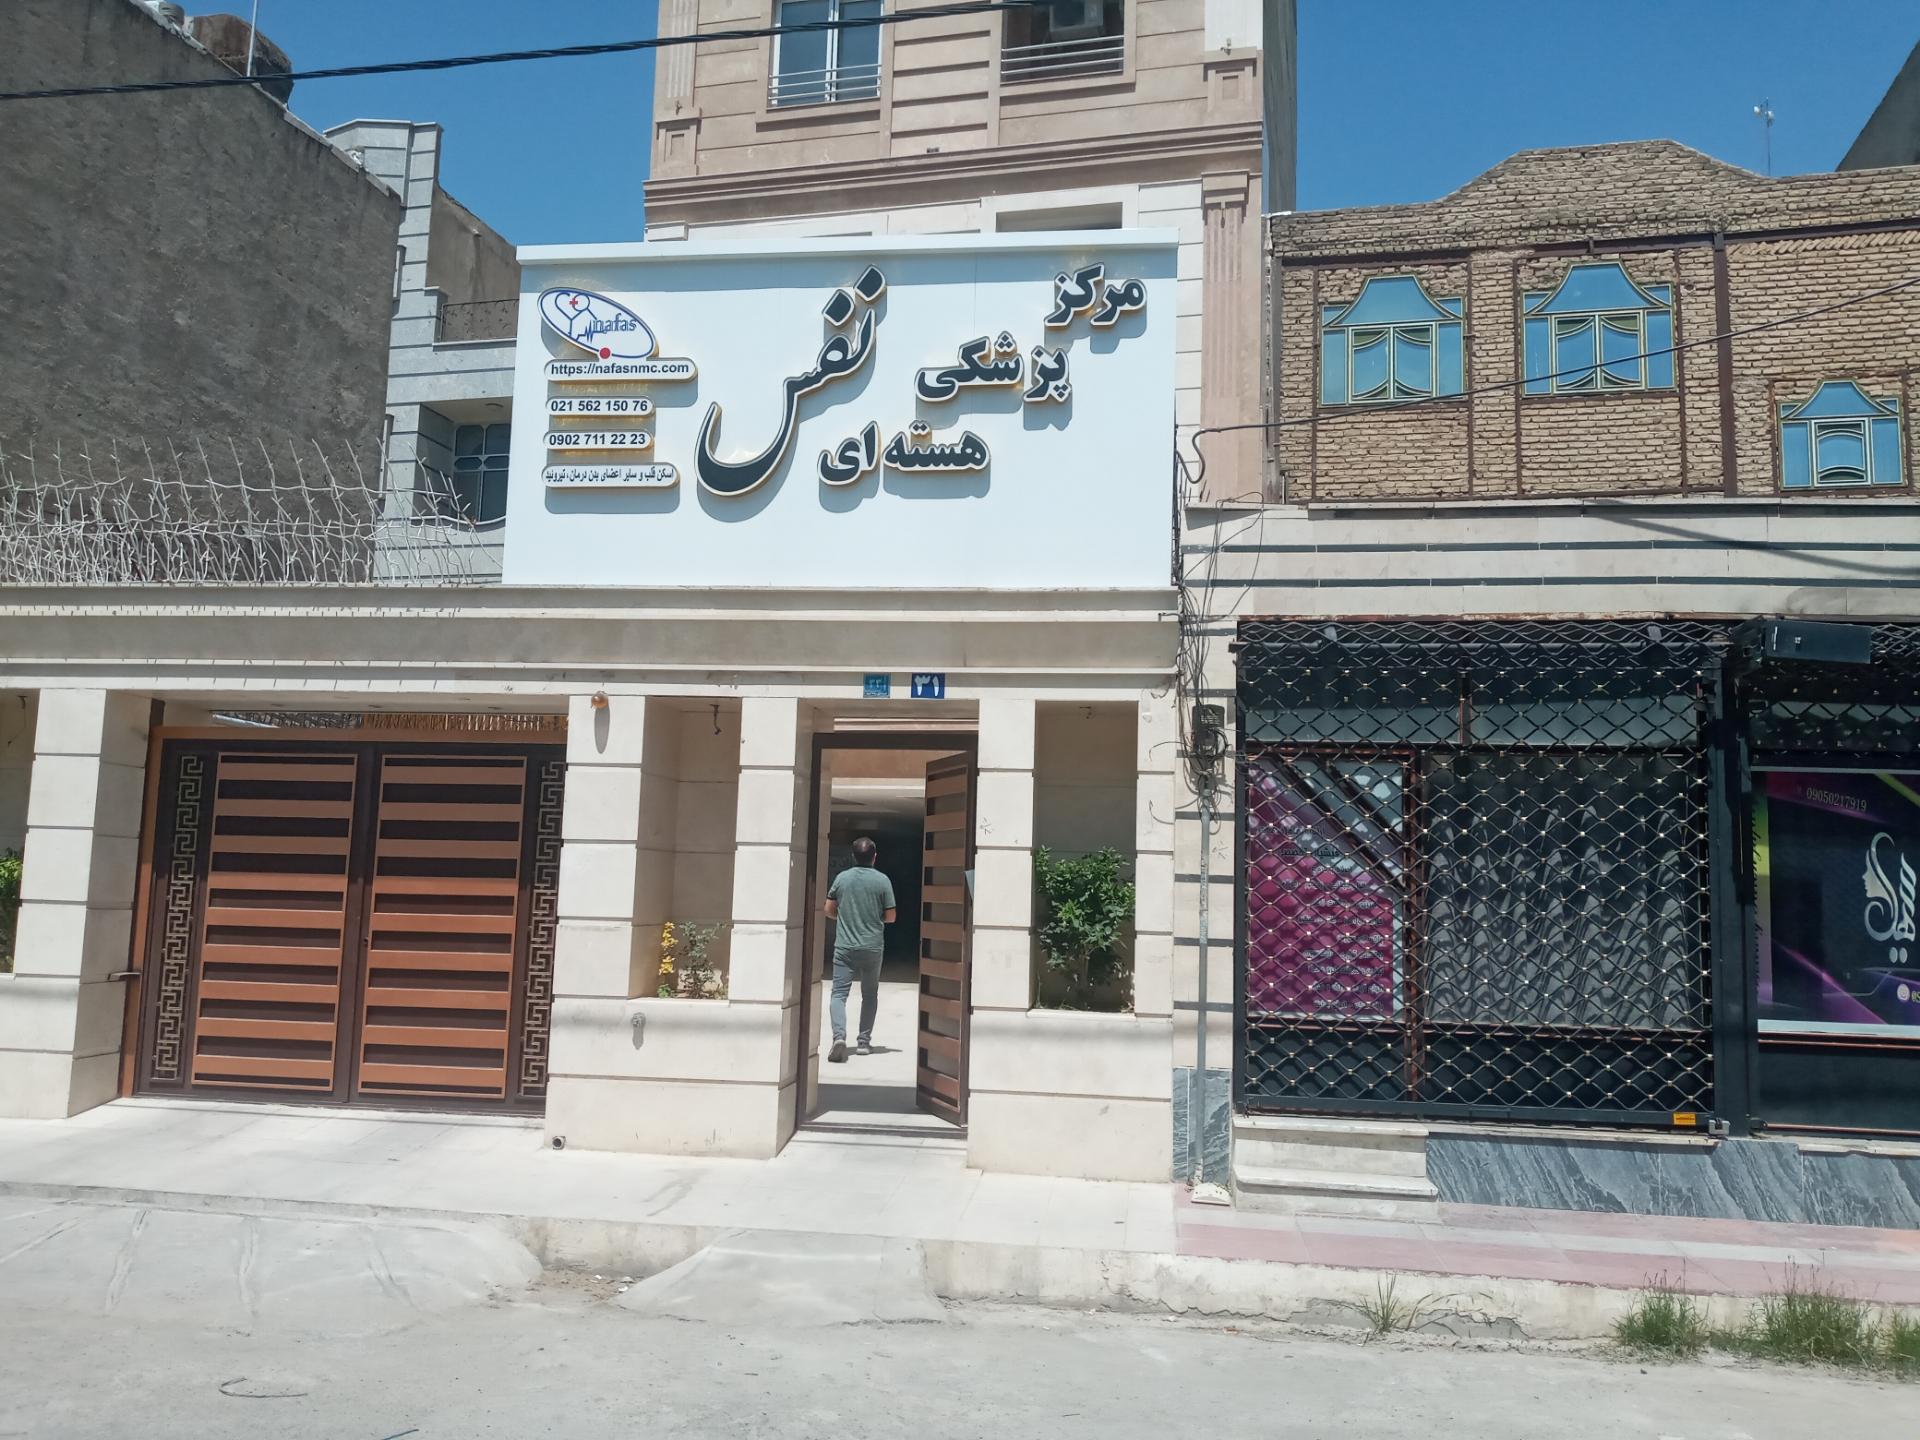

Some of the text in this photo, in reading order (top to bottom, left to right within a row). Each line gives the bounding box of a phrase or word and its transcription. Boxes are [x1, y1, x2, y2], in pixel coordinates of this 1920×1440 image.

[1045, 263, 1147, 327] مرکز
[593, 313, 637, 332] nafas
[551, 363, 689, 376] https://nafasnmc.com
[915, 332, 1071, 403] پزشکی
[695, 265, 887, 497] نفس
[551, 400, 648, 412] 021 562 150 76
[549, 434, 646, 446] 0902 711 22 23
[818, 421, 990, 486] هسته ای
[588, 470, 599, 482] بدن
[600, 468, 622, 482] اعضای
[644, 466, 656, 481] قلب
[657, 468, 674, 481] اسکن
